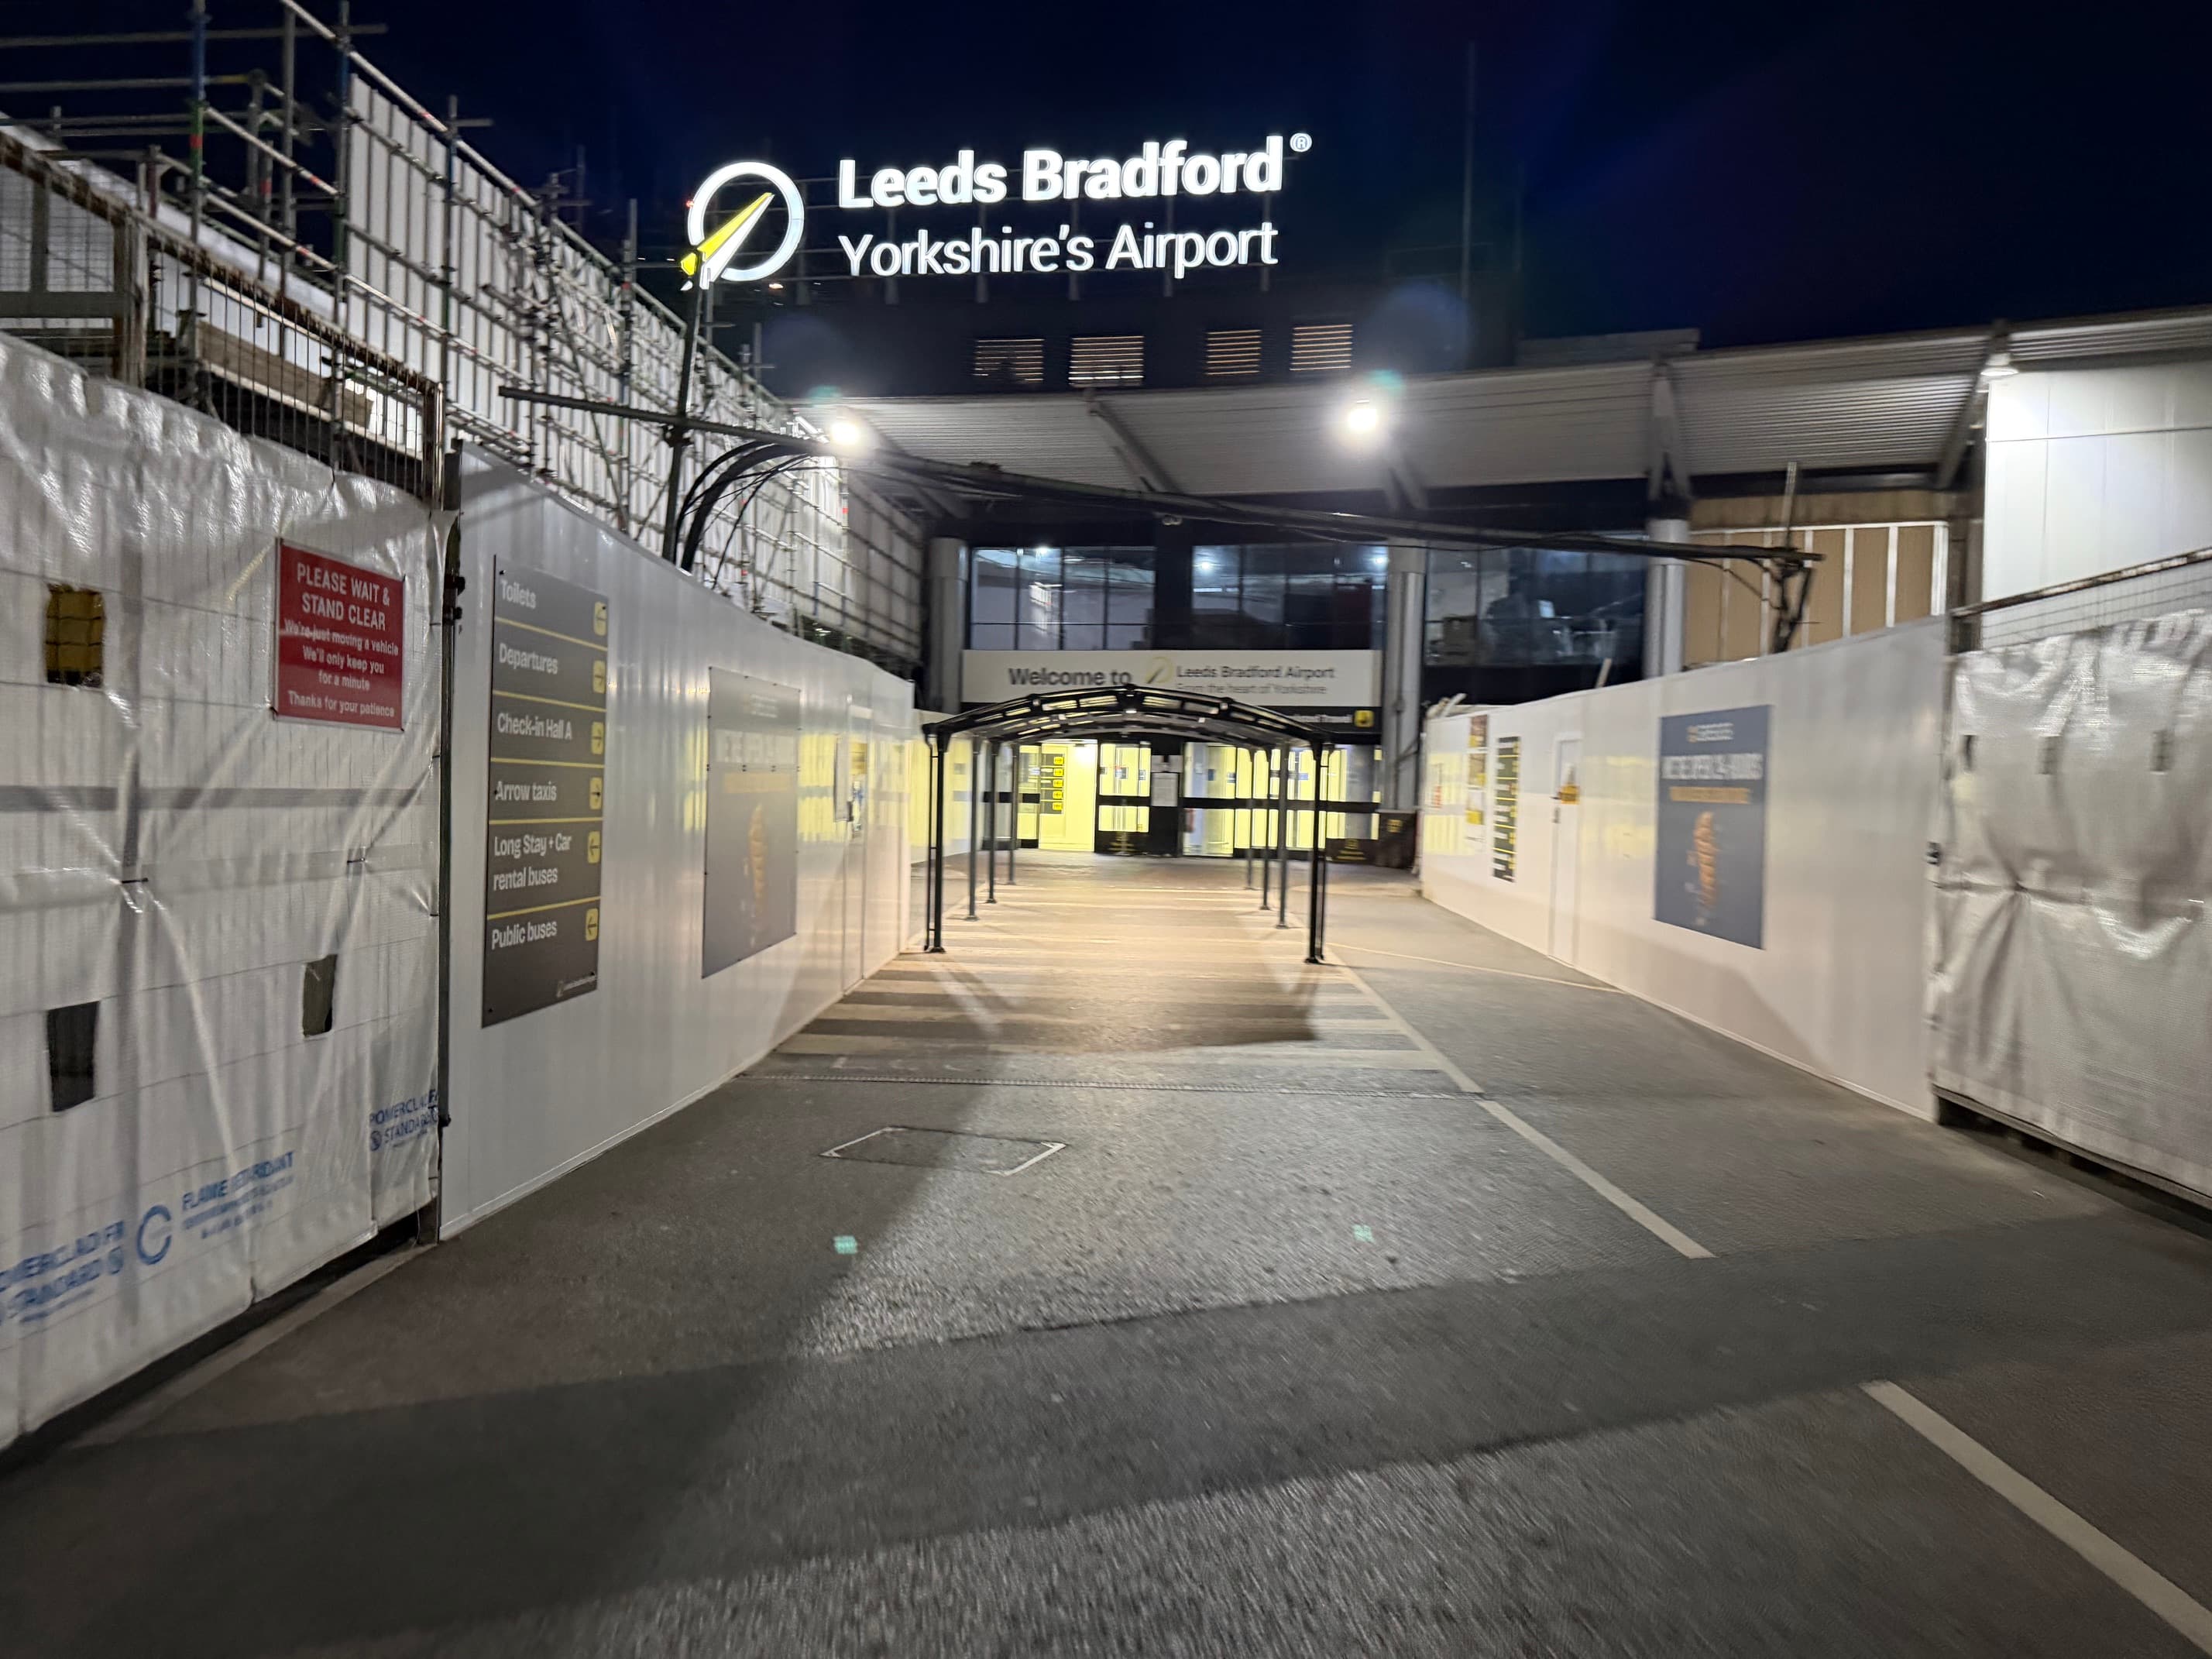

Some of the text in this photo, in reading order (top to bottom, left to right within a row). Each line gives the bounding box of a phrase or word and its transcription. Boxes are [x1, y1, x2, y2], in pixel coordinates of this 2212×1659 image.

[839, 149, 1007, 209] Leeds
[1022, 135, 1283, 201] Bradford
[839, 222, 1278, 280] Yorkshire's Airport
[297, 562, 390, 606] PLEASE WAIT &
[501, 581, 536, 610] Toilets
[302, 593, 386, 630] STAND CLEAR
[311, 625, 331, 641] just
[331, 631, 362, 651] moving
[364, 639, 369, 649] a
[372, 639, 399, 657] vehicle
[303, 645, 384, 675] We'll only keep you
[500, 643, 558, 675] Departures
[1176, 665, 1335, 681] Leeds Bradford Airport
[318, 670, 370, 690] for a minute
[1008, 668, 1133, 685] Welcome to
[288, 690, 394, 717] Thanks for your patience
[497, 713, 572, 740] Check-in Hall A
[495, 781, 558, 802] Arrow taxis
[494, 836, 521, 859] Long
[523, 834, 547, 857] Stay
[555, 833, 572, 851] Car
[493, 867, 558, 891] rental buses
[492, 921, 558, 950] Public buses
